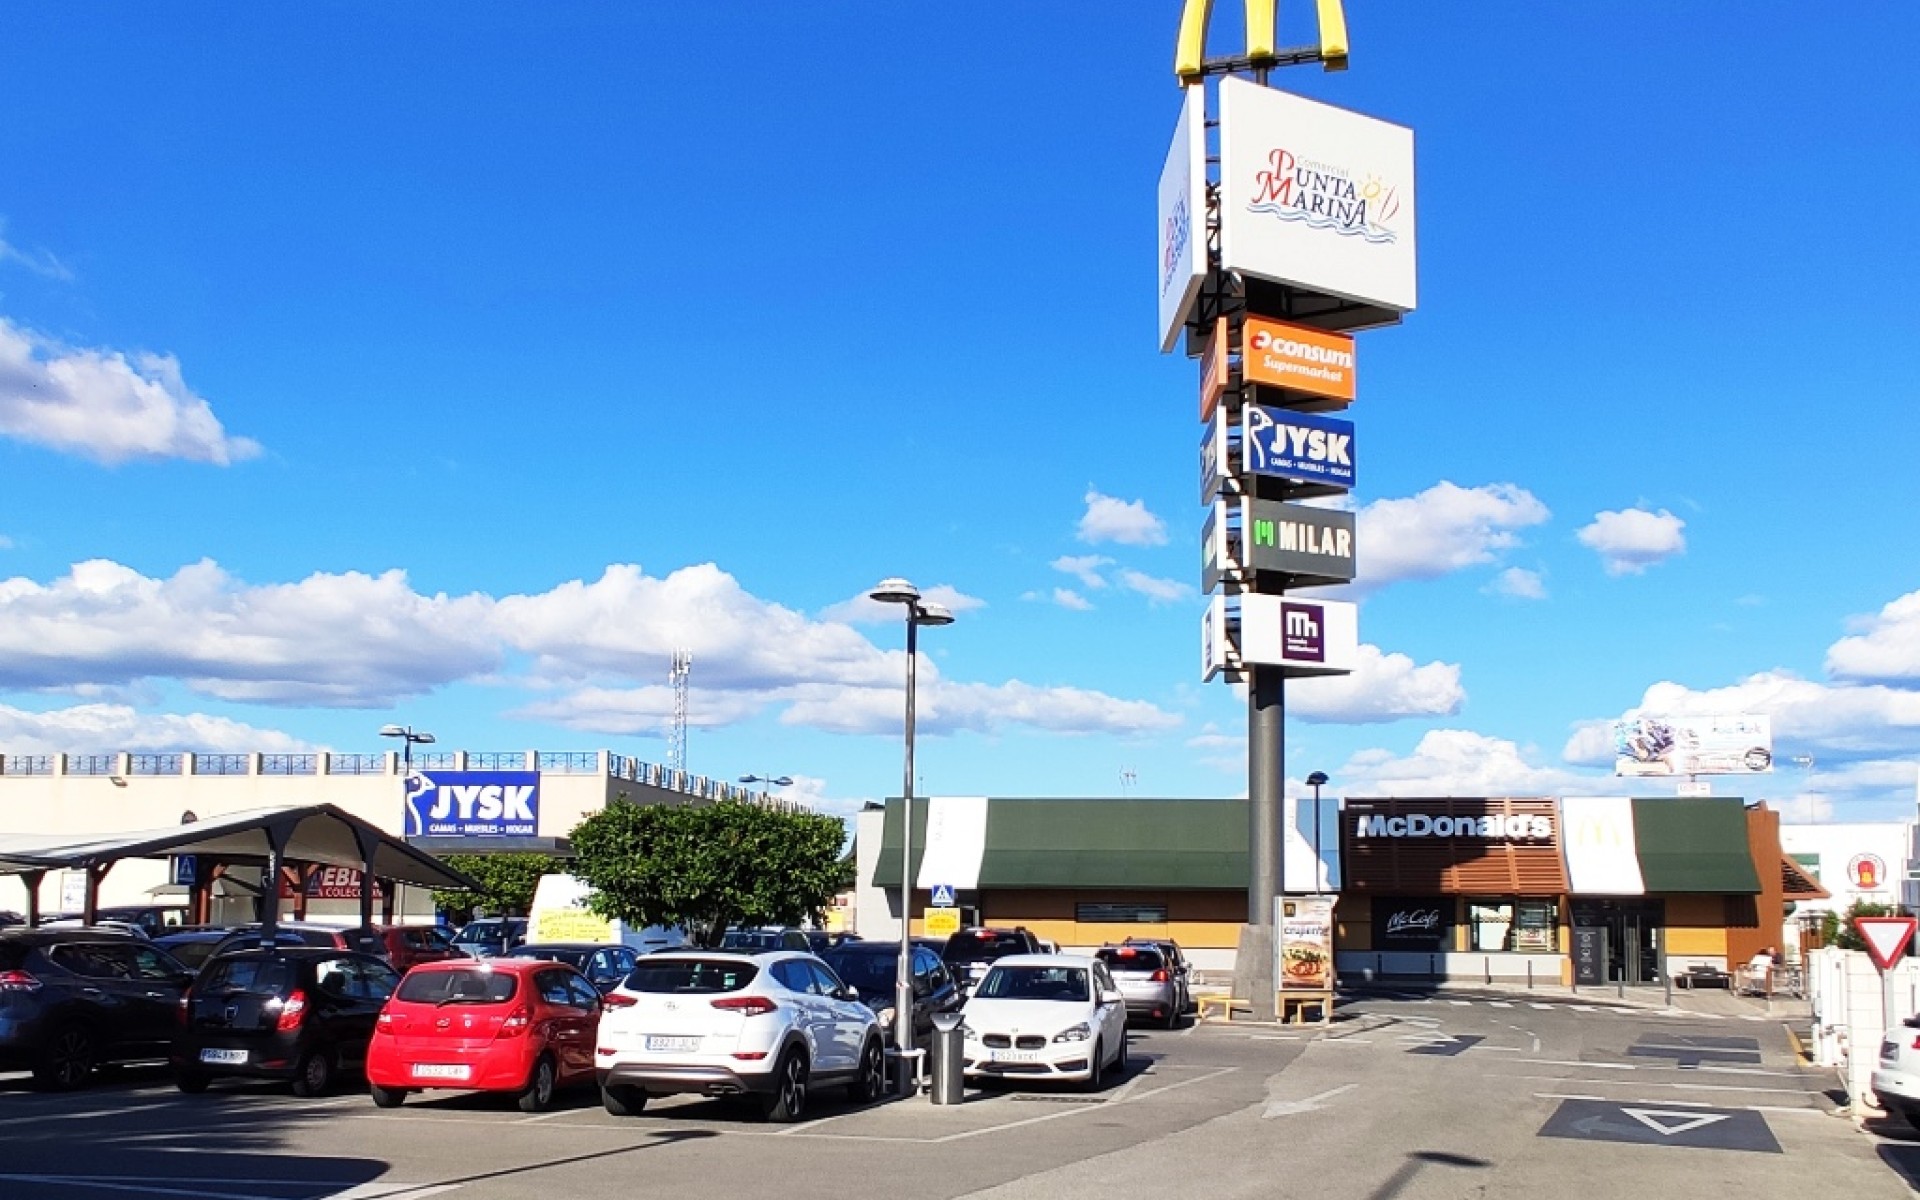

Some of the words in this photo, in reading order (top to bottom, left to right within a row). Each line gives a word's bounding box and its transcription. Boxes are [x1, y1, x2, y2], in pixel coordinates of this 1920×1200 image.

[1269, 149, 1357, 201] PUNTA
[1252, 171, 1367, 228] MARINA
[1264, 354, 1342, 382] Supermarket
[1273, 338, 1352, 368] consum
[1270, 424, 1351, 466] JYSK
[1279, 521, 1351, 558] MILAR
[429, 785, 535, 820] JYSK
[1357, 813, 1552, 839] McDonald's
